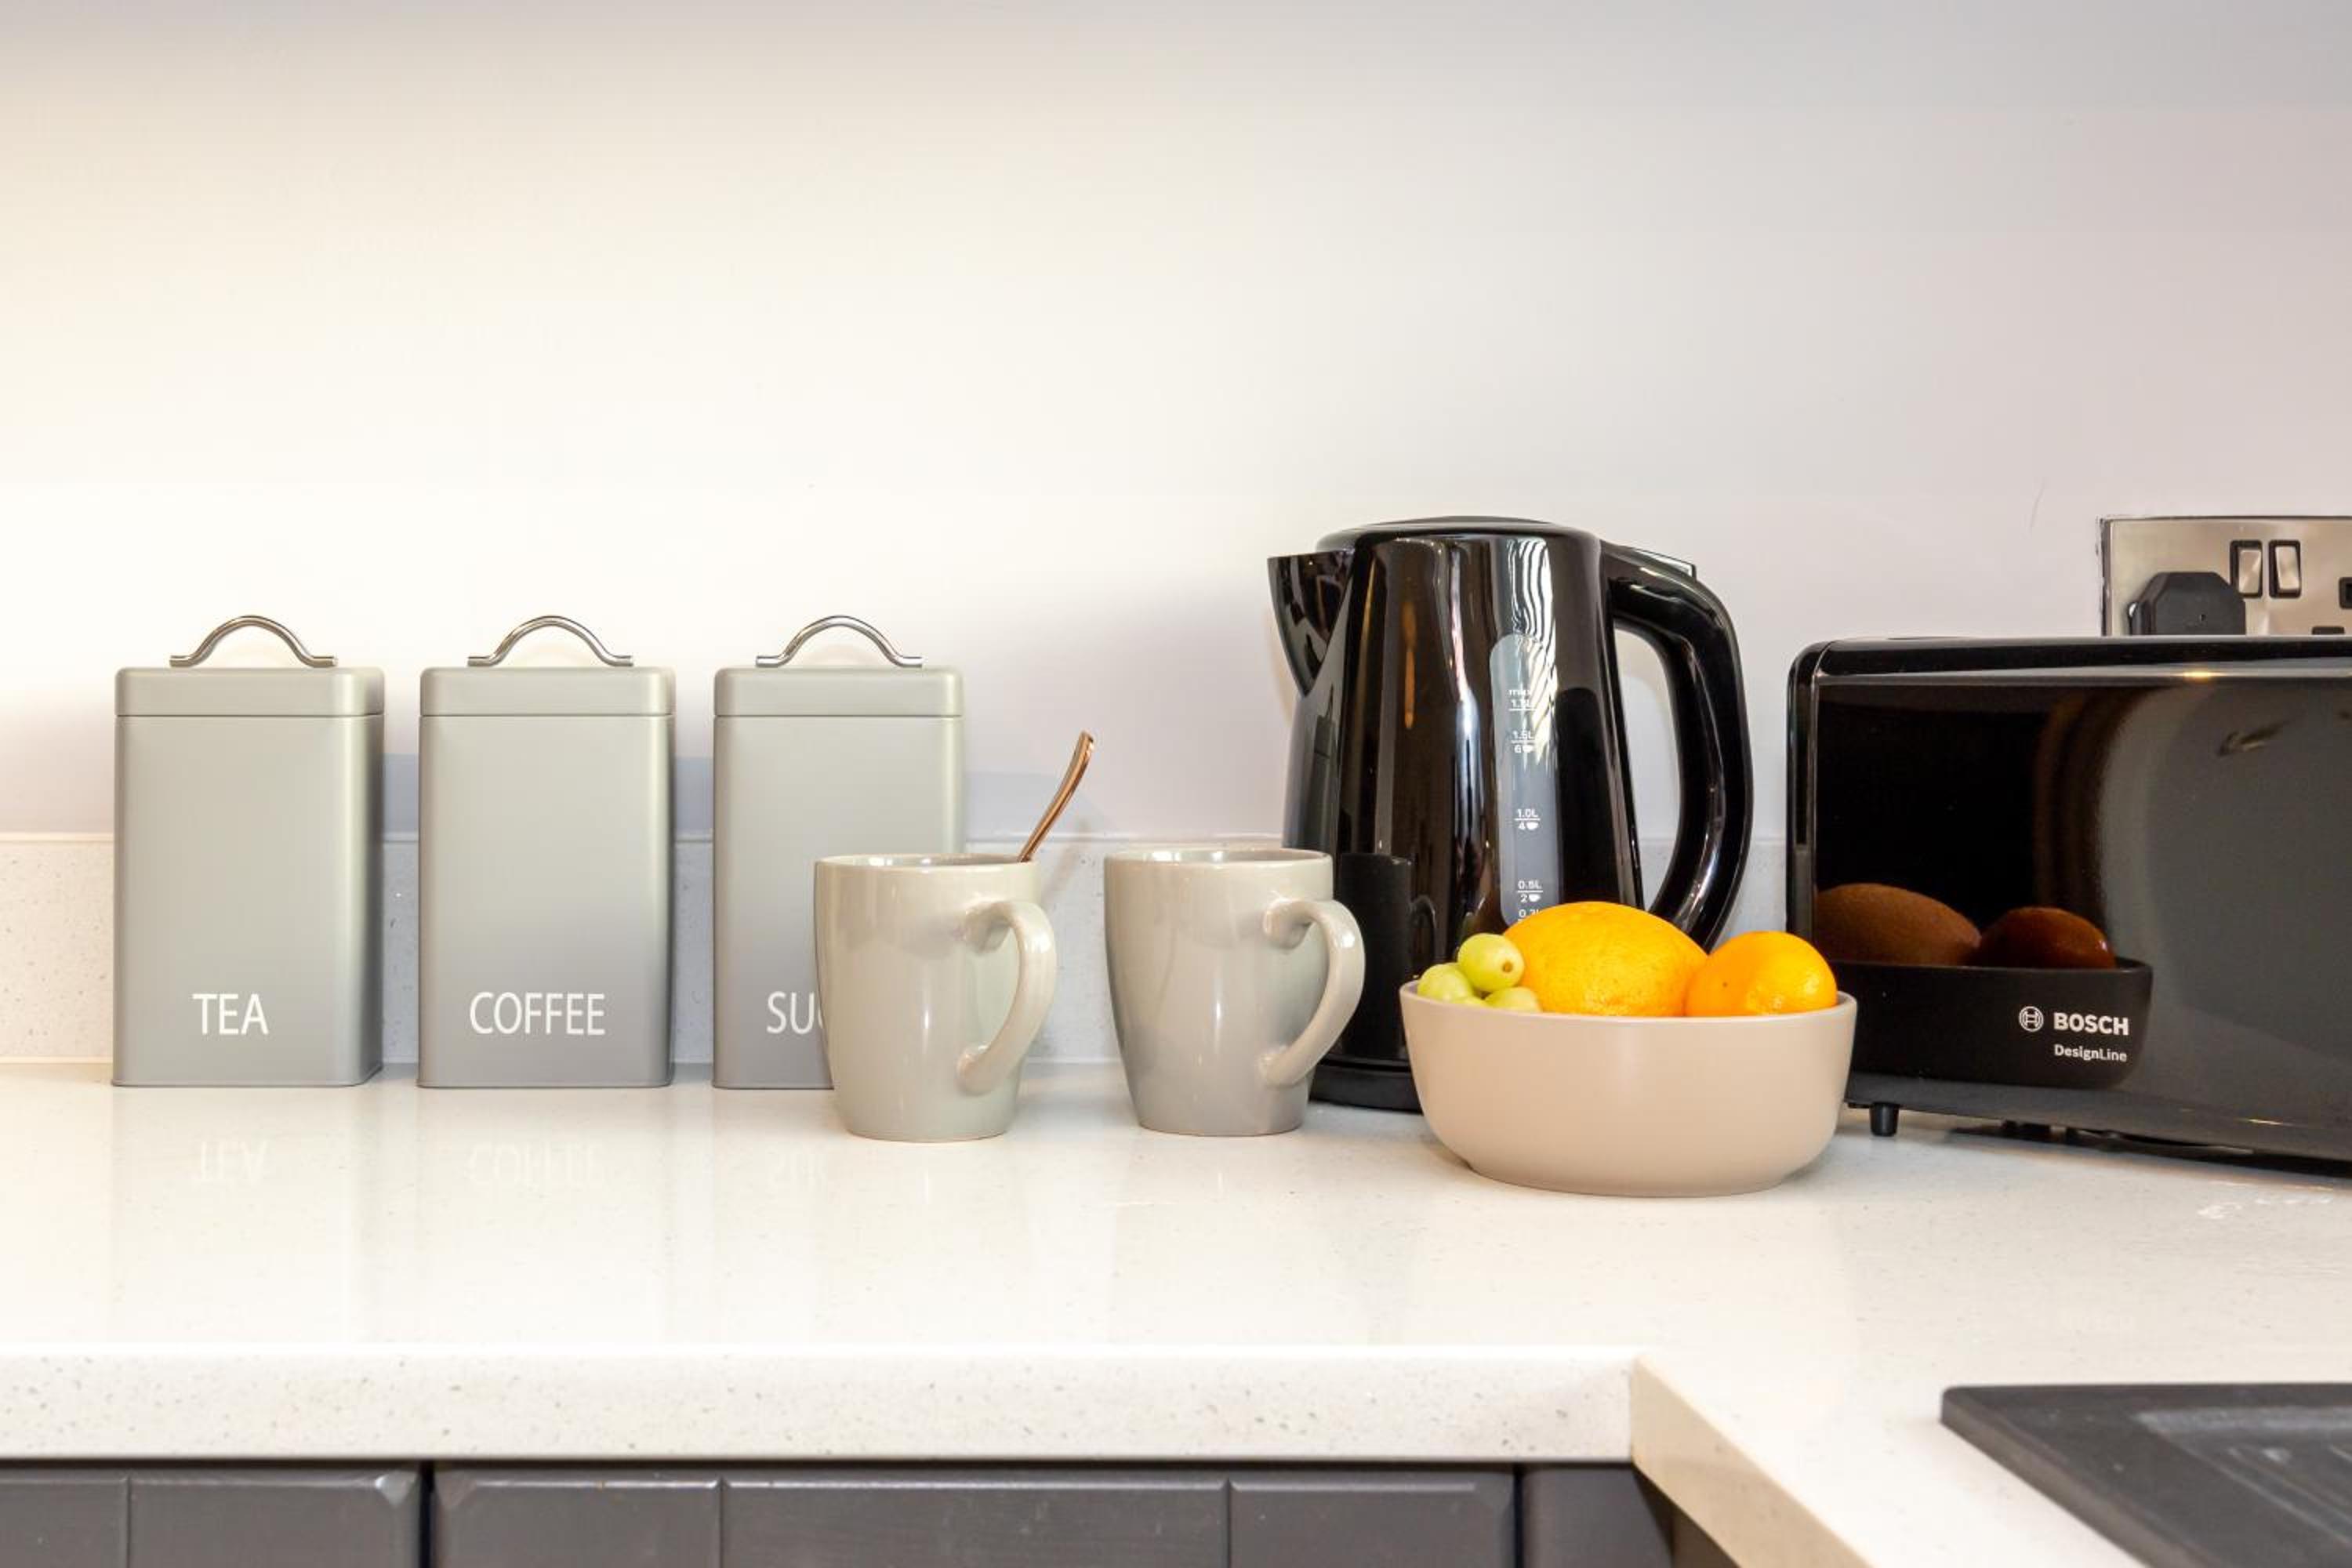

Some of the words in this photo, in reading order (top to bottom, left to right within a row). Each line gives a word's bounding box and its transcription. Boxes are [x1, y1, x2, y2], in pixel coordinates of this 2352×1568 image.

[1516, 808, 1539, 818] 1.0L
[1518, 822, 1526, 831] 4
[1518, 880, 1542, 890] 0.5L
[1520, 894, 1528, 903] 2
[192, 993, 269, 1035] TEA
[470, 992, 606, 1035] COFFEE
[766, 991, 822, 1034] SU
[2053, 1012, 2129, 1036] BOSCH
[2054, 1044, 2127, 1062] DesignLine
